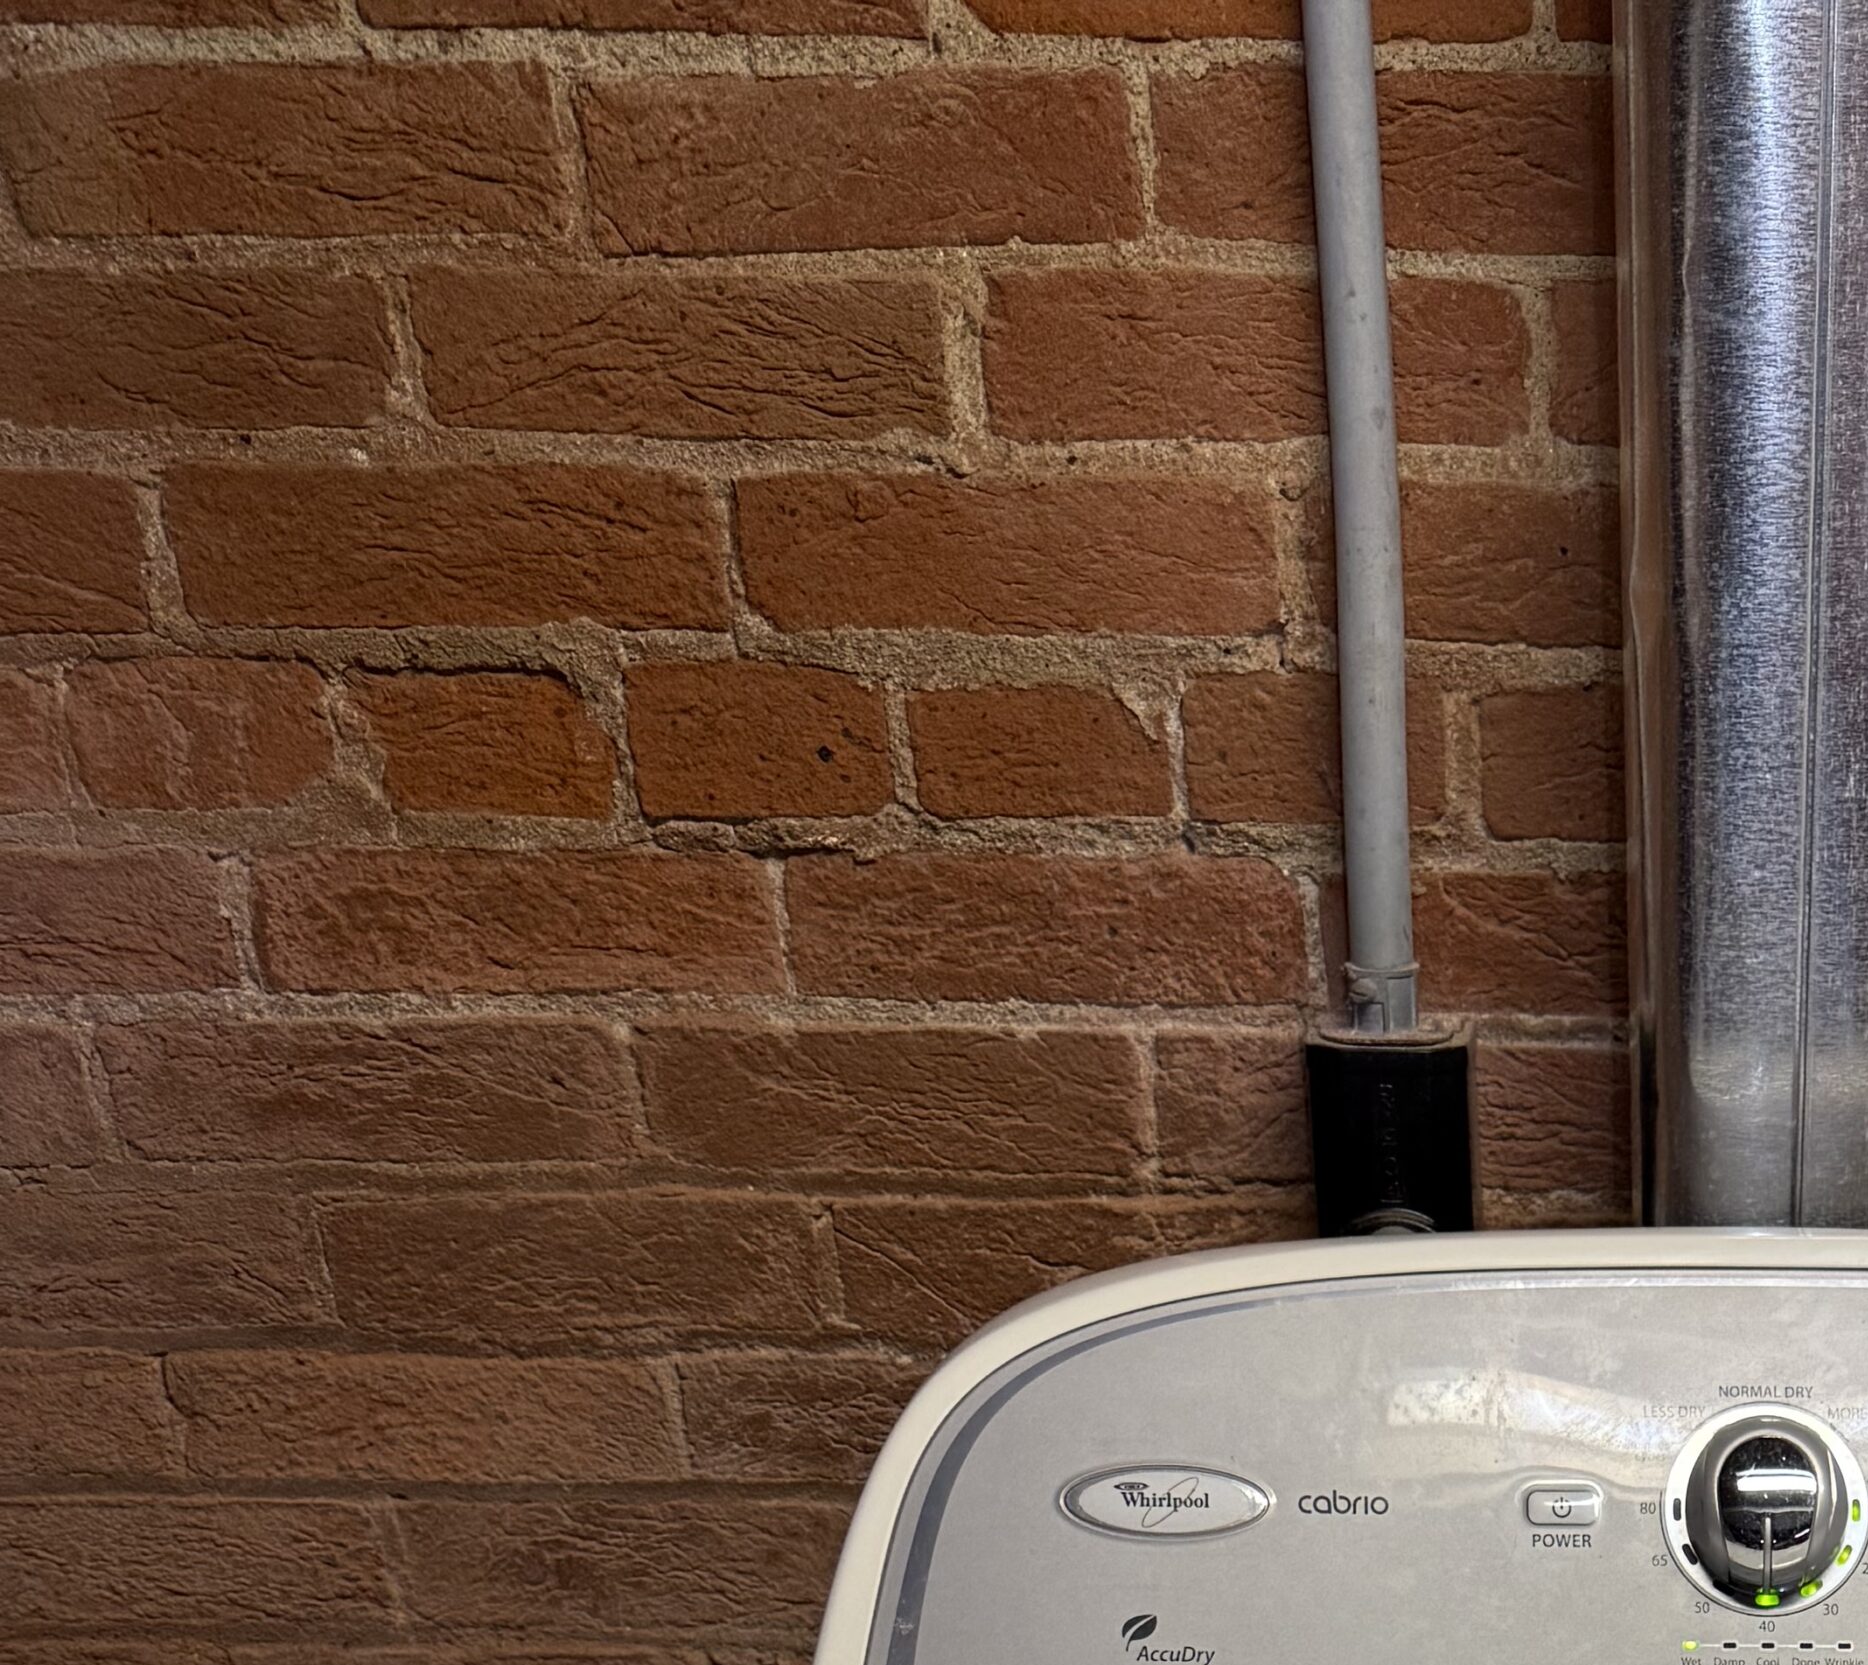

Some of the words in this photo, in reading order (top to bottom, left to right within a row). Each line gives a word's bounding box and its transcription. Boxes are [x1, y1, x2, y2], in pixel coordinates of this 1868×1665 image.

[1718, 1385, 1781, 1399] NORMAL
[1784, 1385, 1814, 1399] DRY
[1643, 1405, 1675, 1418] LESS
[1678, 1405, 1707, 1419] DRY
[1827, 1407, 1868, 1420] MORE
[1121, 1491, 1210, 1512] Whirlpool
[1297, 1489, 1390, 1516] cabrio
[1639, 1502, 1657, 1515] 80
[1531, 1532, 1593, 1549] POWER
[1651, 1554, 1668, 1567] 65
[1694, 1602, 1711, 1615] 50
[1822, 1603, 1839, 1616] 30
[1758, 1620, 1776, 1633] 40
